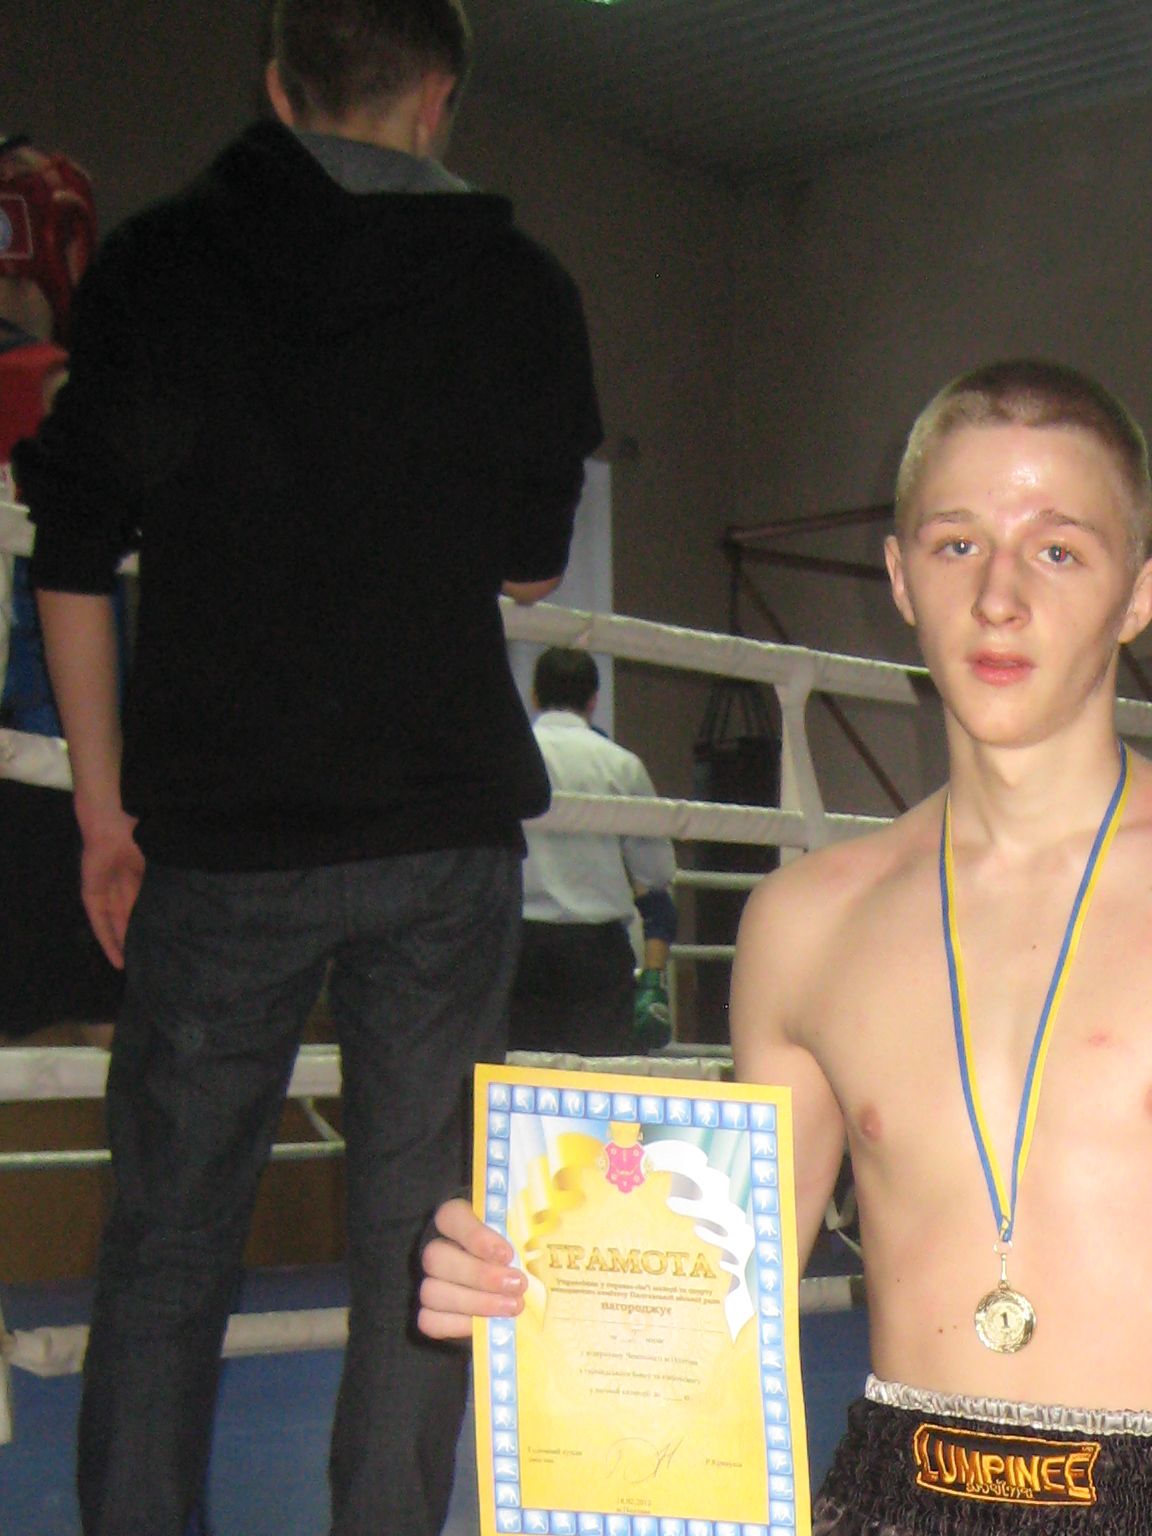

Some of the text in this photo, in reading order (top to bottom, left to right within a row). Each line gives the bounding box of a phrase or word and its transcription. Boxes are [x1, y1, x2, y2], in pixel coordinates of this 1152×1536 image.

[547, 1243, 717, 1279] ГРАМОТА
[1000, 1312, 1010, 1329] 1
[921, 1433, 1092, 1499] LUMPINEE
